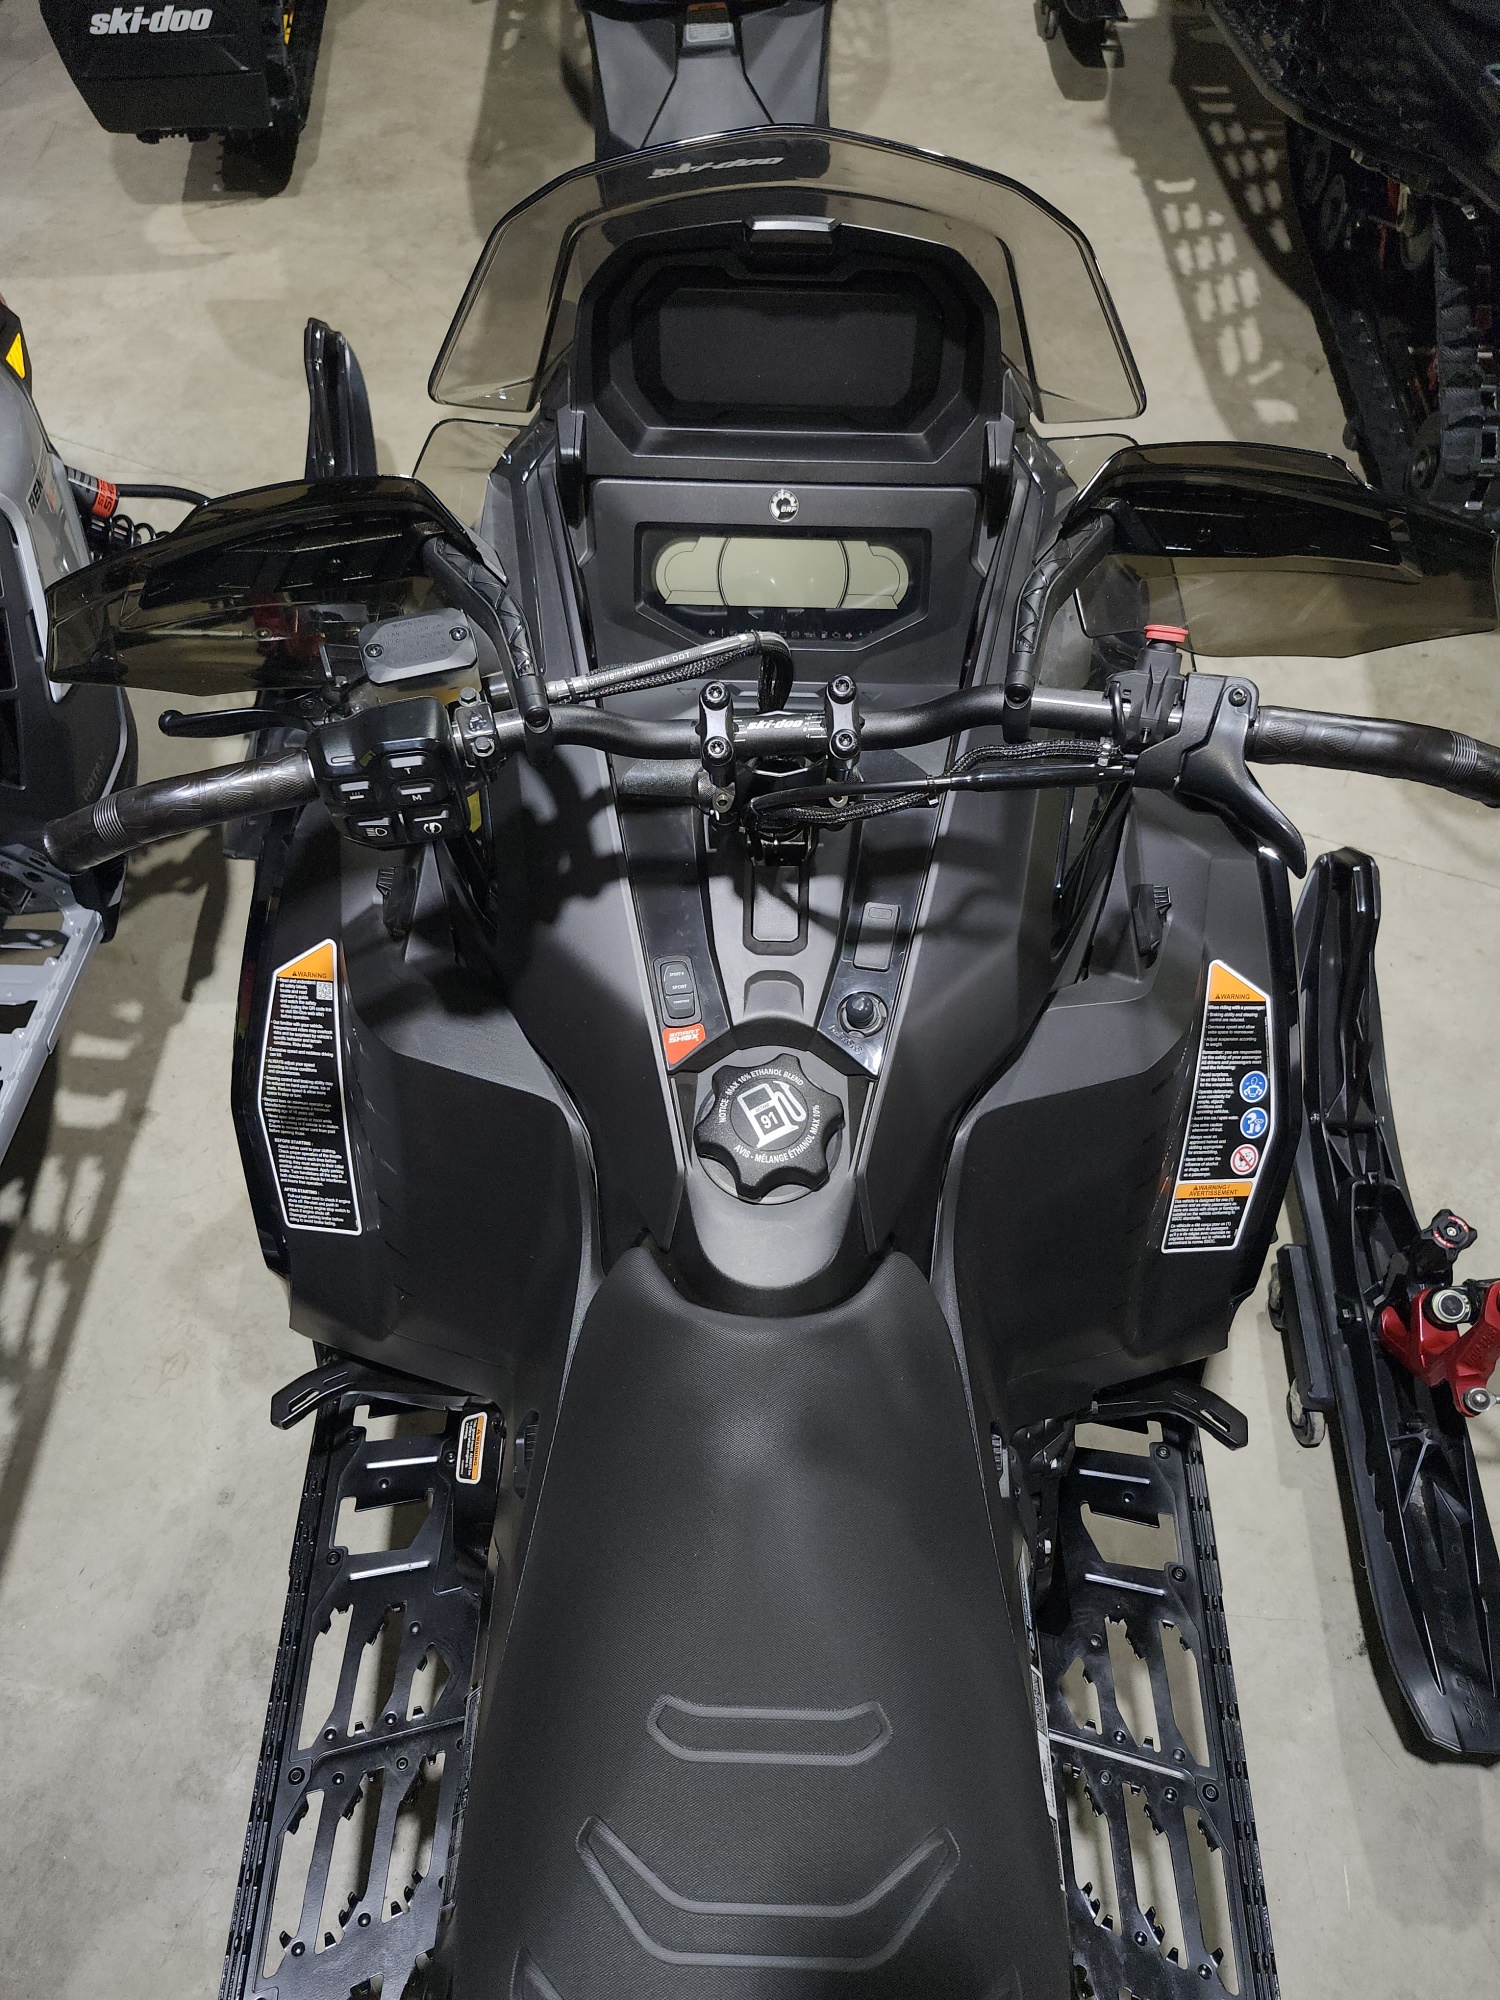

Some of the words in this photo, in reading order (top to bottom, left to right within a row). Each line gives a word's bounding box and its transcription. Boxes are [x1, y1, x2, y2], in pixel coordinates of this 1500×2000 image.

[89, 5, 213, 35] ski-doo
[672, 652, 690, 662] DOT
[747, 718, 804, 730] ski-doo
[719, 1098, 729, 1123] NOTICE
[725, 1081, 740, 1096] MAX
[738, 1073, 751, 1083] 10%
[750, 1068, 783, 1078] ETHANOL
[783, 1070, 804, 1086] BLEND
[812, 1105, 820, 1117] 10%
[760, 1112, 778, 1128] 91
[810, 1118, 820, 1135] MAX
[734, 1144, 750, 1158] AVIS
[788, 1135, 815, 1158] ÉTHANOL
[754, 1153, 789, 1164] MÉLANGE
